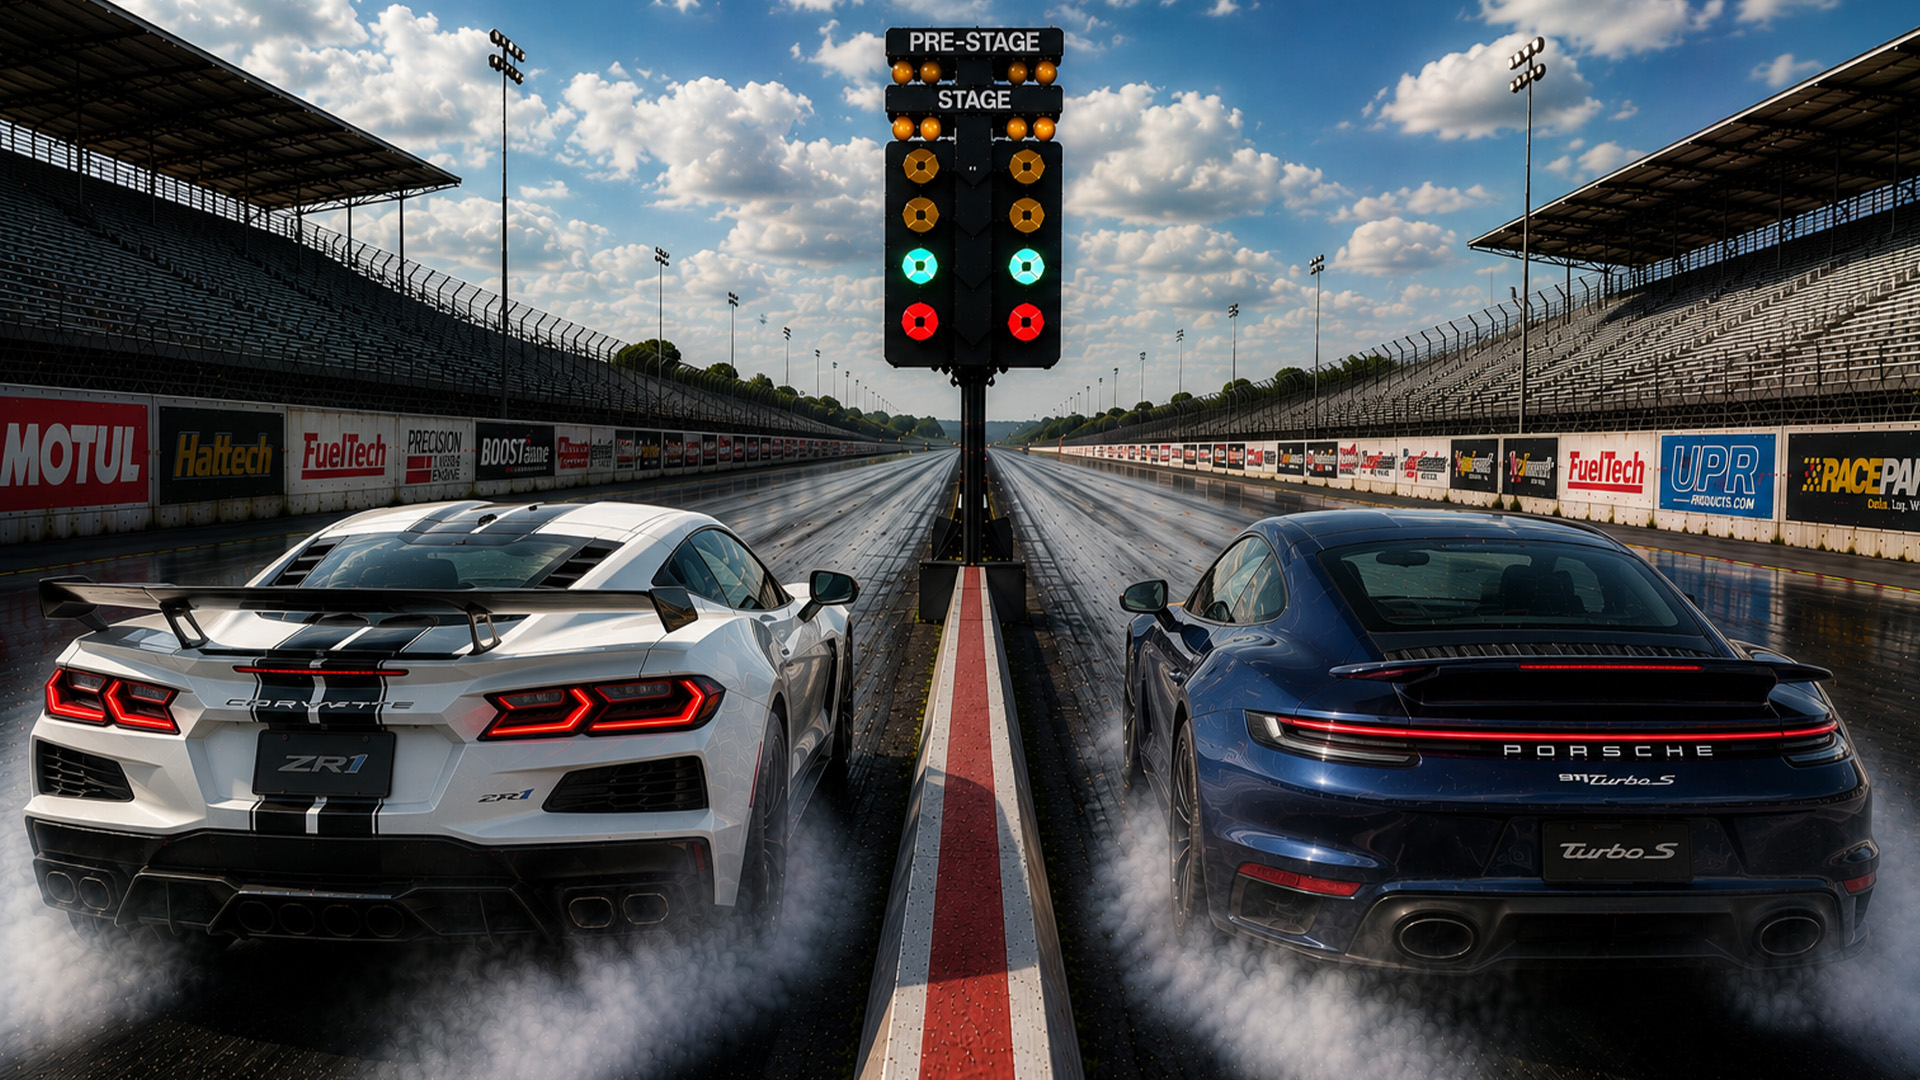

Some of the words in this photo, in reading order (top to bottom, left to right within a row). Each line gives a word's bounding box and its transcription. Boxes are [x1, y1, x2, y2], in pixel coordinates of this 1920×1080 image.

[909, 31, 1040, 52] PRE-STAGE
[938, 89, 1011, 110] STAGE
[302, 432, 387, 469] FuelTech
[407, 429, 462, 454] PRECISION
[0, 422, 140, 487] MOTUL
[173, 431, 273, 480] Haltech
[1568, 450, 1645, 484] FuelTech
[1671, 445, 1759, 495] UPR
[1503, 744, 1713, 757] PORSCHE
[277, 753, 369, 774] ZR1
[1559, 842, 1644, 860] Turbo
[1644, 842, 1679, 860] S
